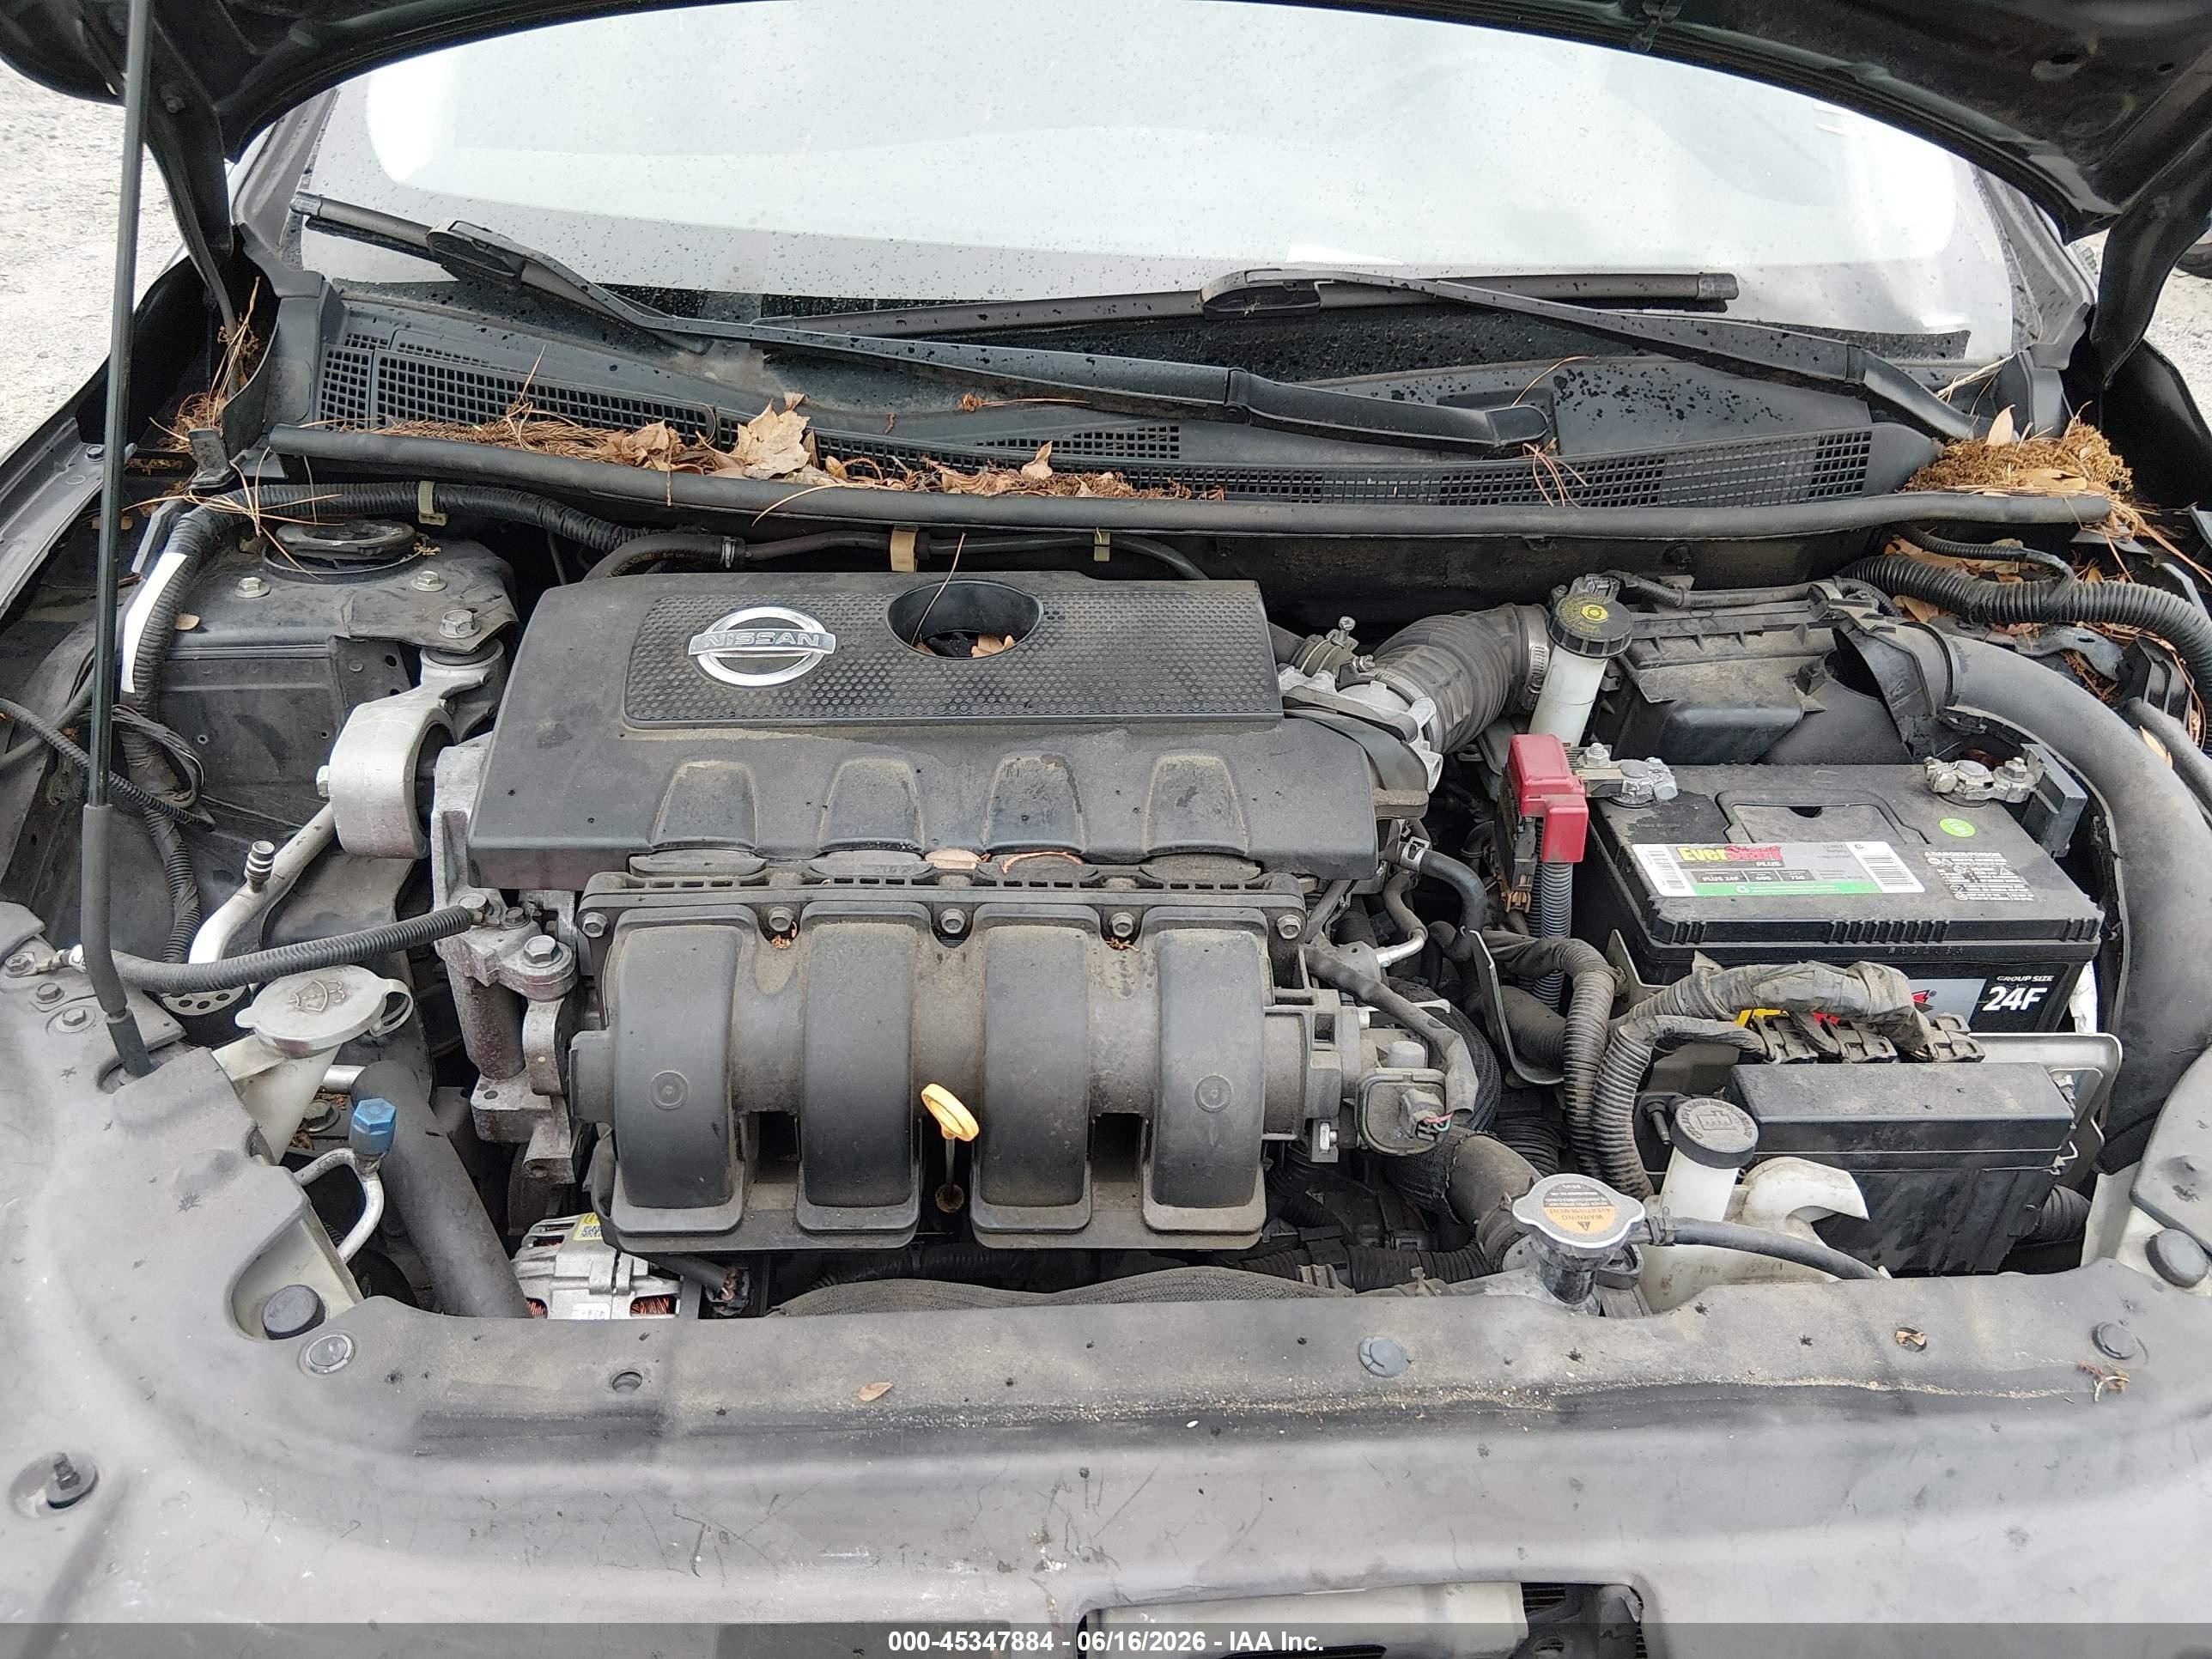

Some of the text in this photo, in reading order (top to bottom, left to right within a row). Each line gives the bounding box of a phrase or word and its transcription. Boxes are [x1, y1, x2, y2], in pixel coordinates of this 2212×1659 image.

[705, 632, 819, 647] NISSAN
[1676, 845, 1783, 861] EverStart
[1982, 986, 2048, 1012] 24F
